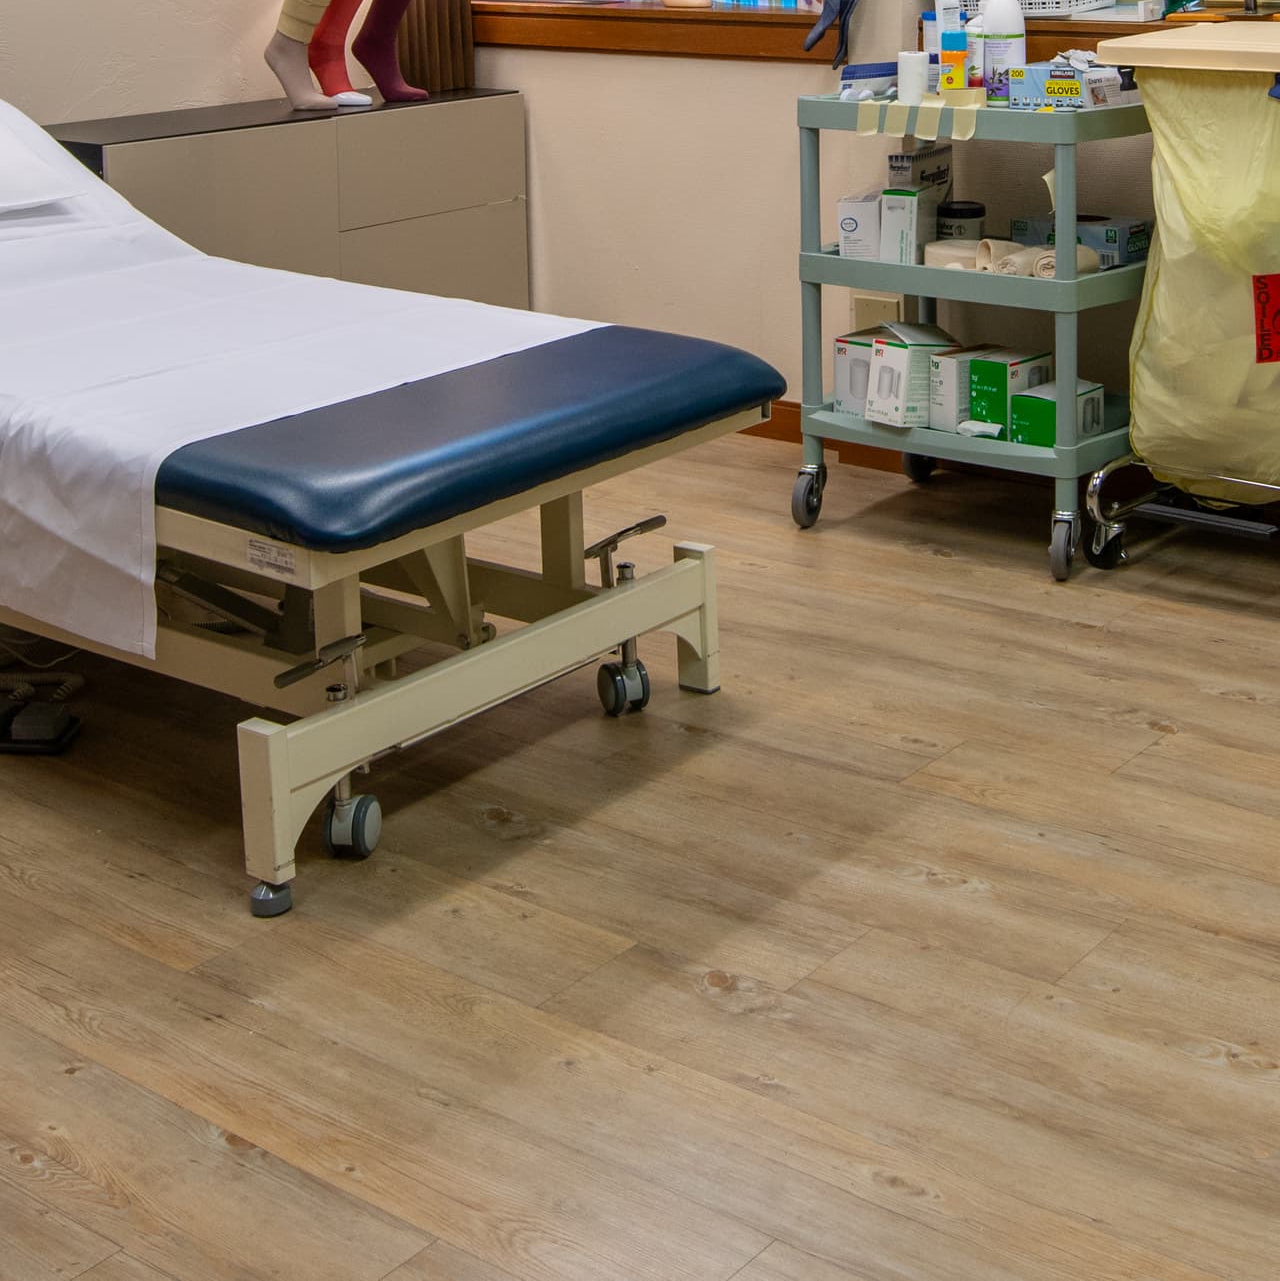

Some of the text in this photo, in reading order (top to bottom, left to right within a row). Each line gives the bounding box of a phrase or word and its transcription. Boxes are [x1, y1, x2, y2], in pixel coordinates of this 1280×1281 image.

[1011, 69, 1024, 78] 200
[1046, 86, 1080, 96] GLOVES
[1107, 229, 1115, 238] M
[1255, 275, 1273, 360] SOILED
[931, 359, 939, 370] tg
